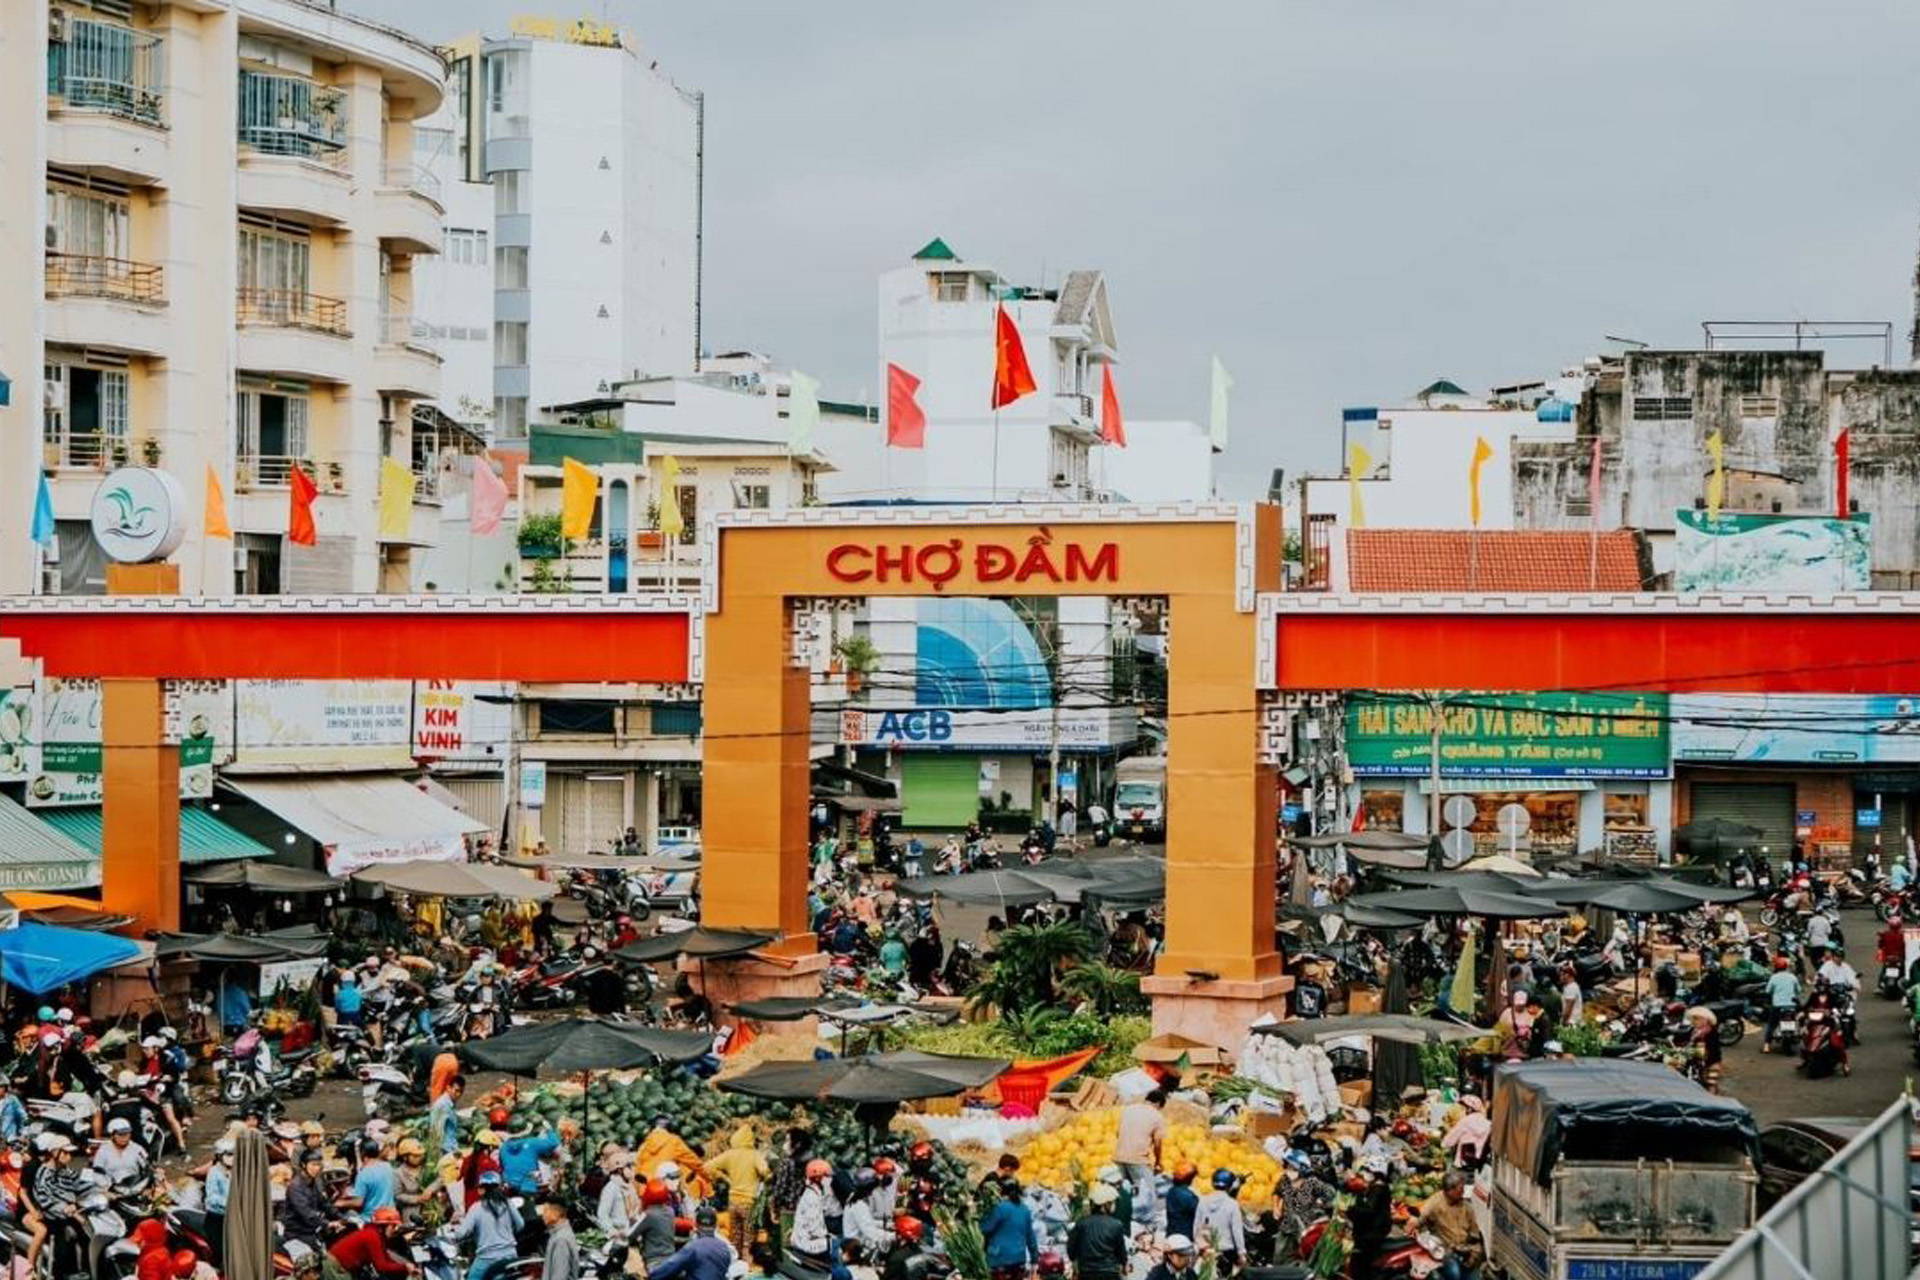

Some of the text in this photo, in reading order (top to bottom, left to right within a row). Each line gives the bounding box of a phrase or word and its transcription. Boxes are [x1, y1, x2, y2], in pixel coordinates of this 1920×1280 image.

[826, 527, 1118, 591] CHỢ ĐẦM
[425, 708, 457, 727] KIM
[876, 711, 952, 741] ACB
[418, 731, 462, 750] VINH
